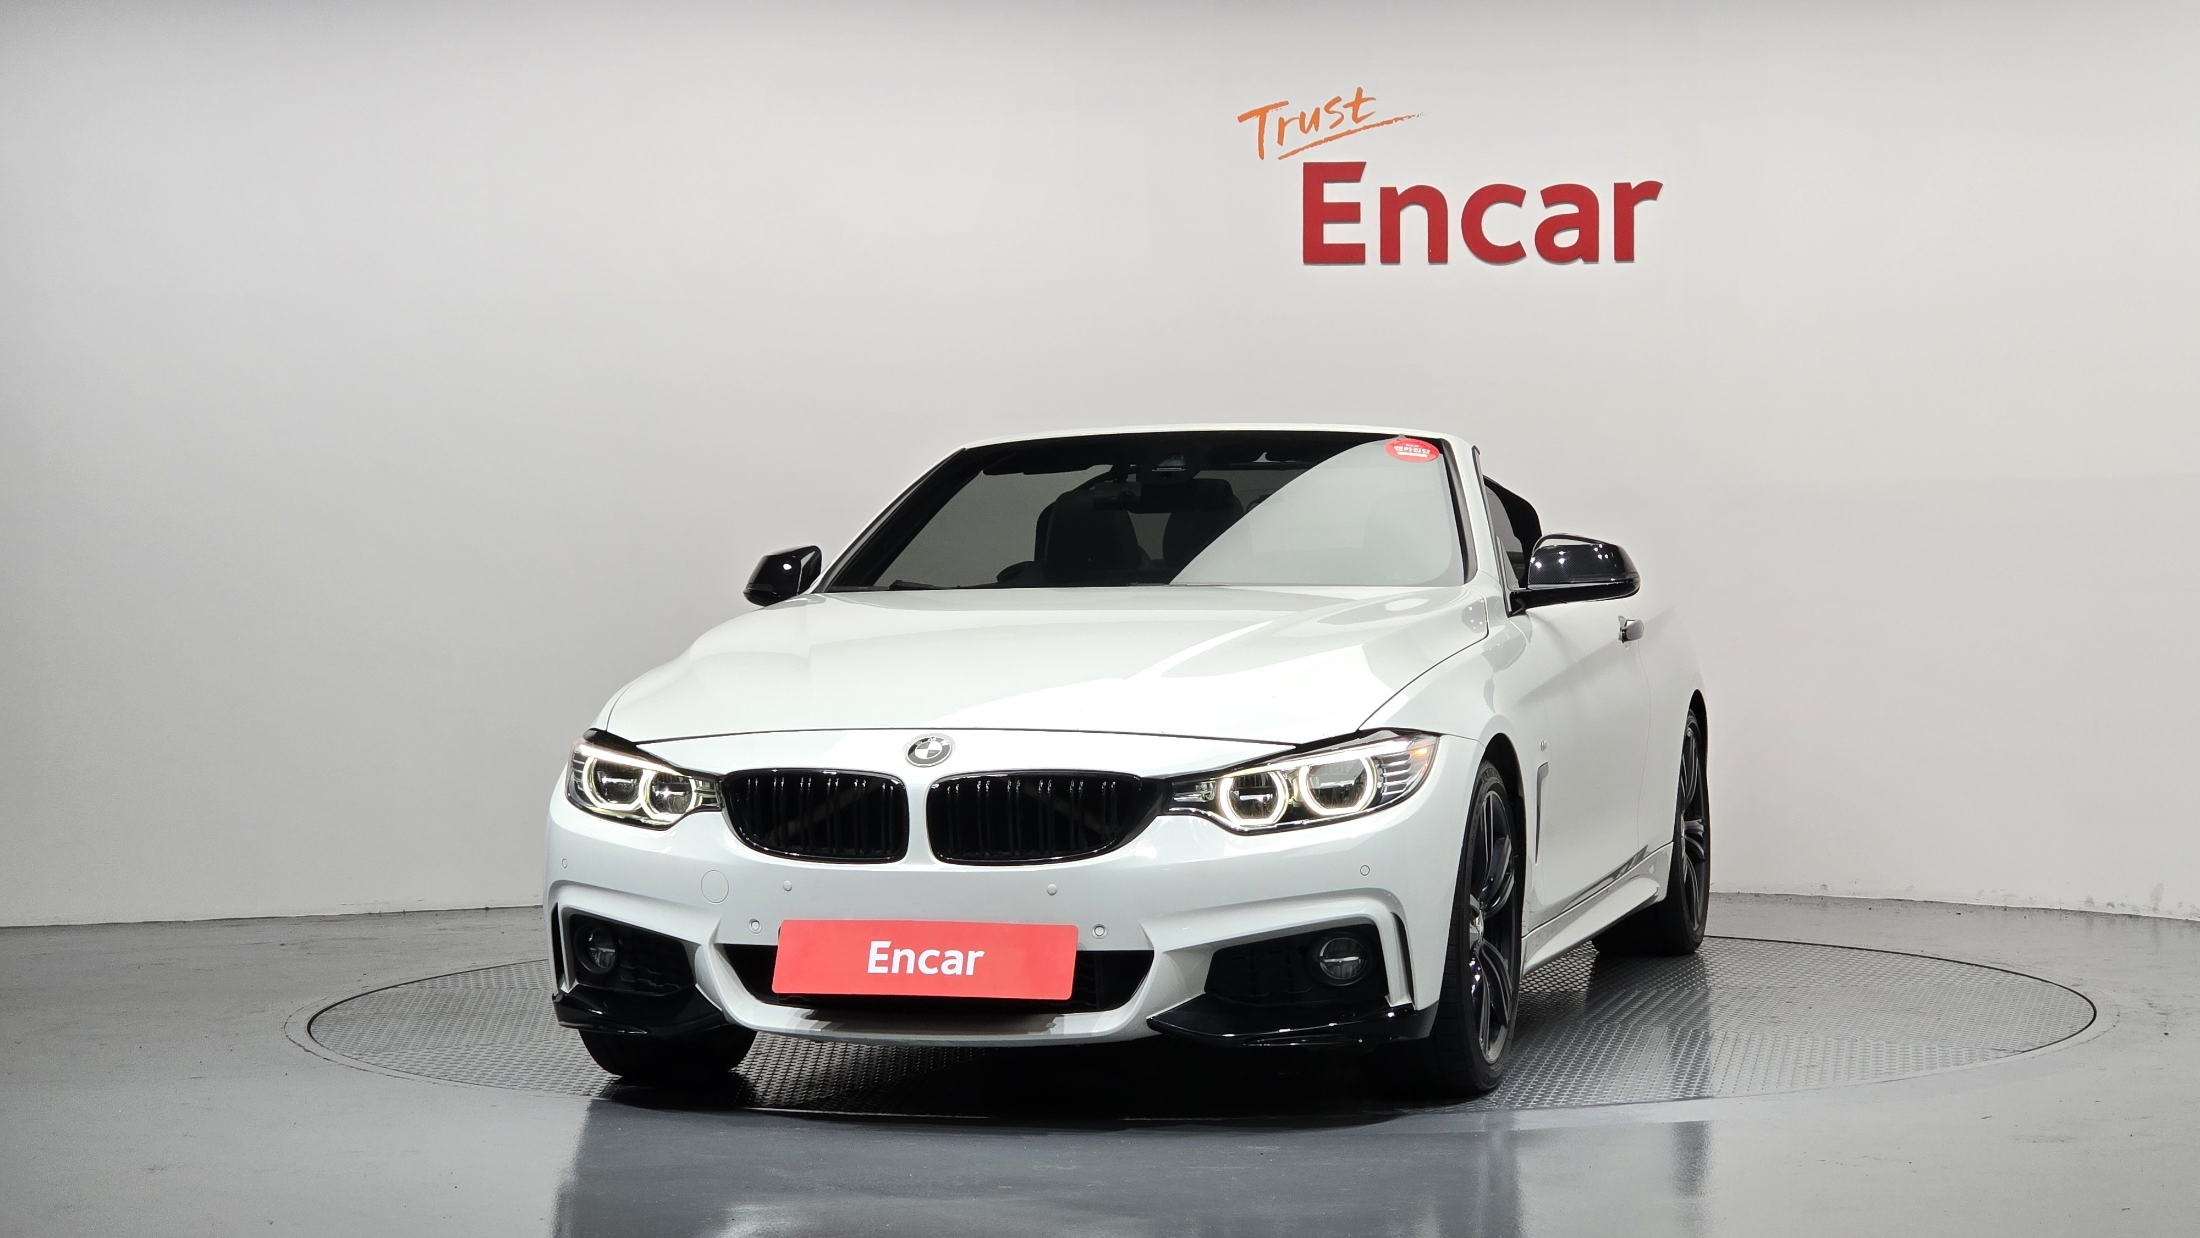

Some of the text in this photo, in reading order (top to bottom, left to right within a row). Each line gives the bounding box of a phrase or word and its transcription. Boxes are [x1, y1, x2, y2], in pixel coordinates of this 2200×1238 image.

[1237, 87, 1377, 160] Trust
[1303, 162, 1663, 264] Encar
[867, 941, 985, 976] Encar
